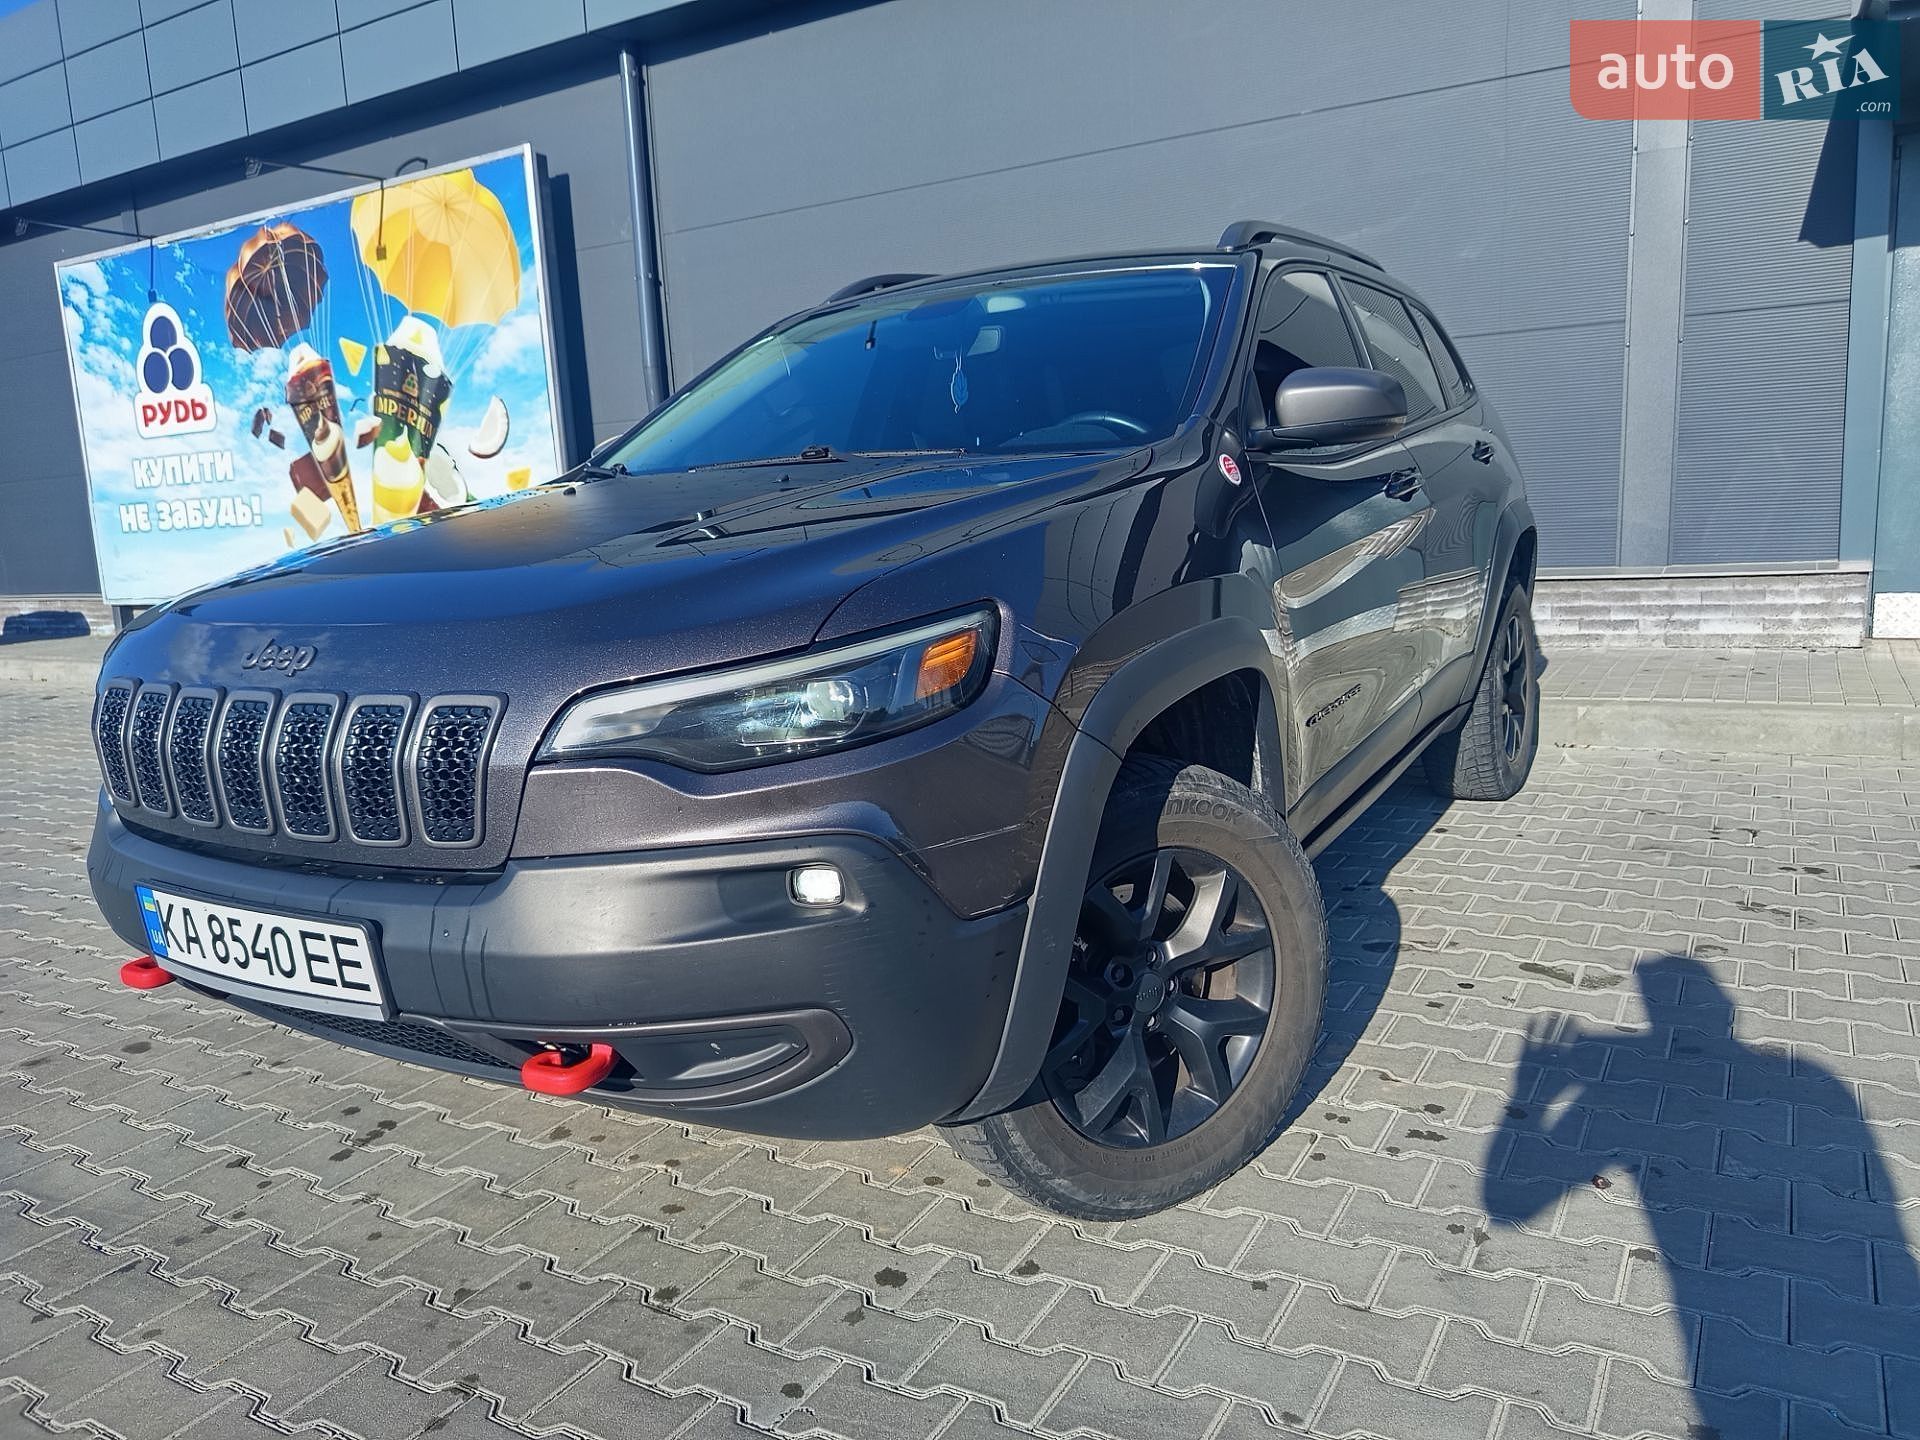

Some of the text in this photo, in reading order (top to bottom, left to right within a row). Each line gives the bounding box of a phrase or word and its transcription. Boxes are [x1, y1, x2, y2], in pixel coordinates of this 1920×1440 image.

[142, 398, 208, 428] РУДЬ
[132, 450, 235, 489] КУПИТИ
[120, 502, 152, 533] НЕ
[241, 638, 319, 678] Jeep
[151, 928, 166, 947] UA
[156, 899, 372, 992] KA 8540 EE
